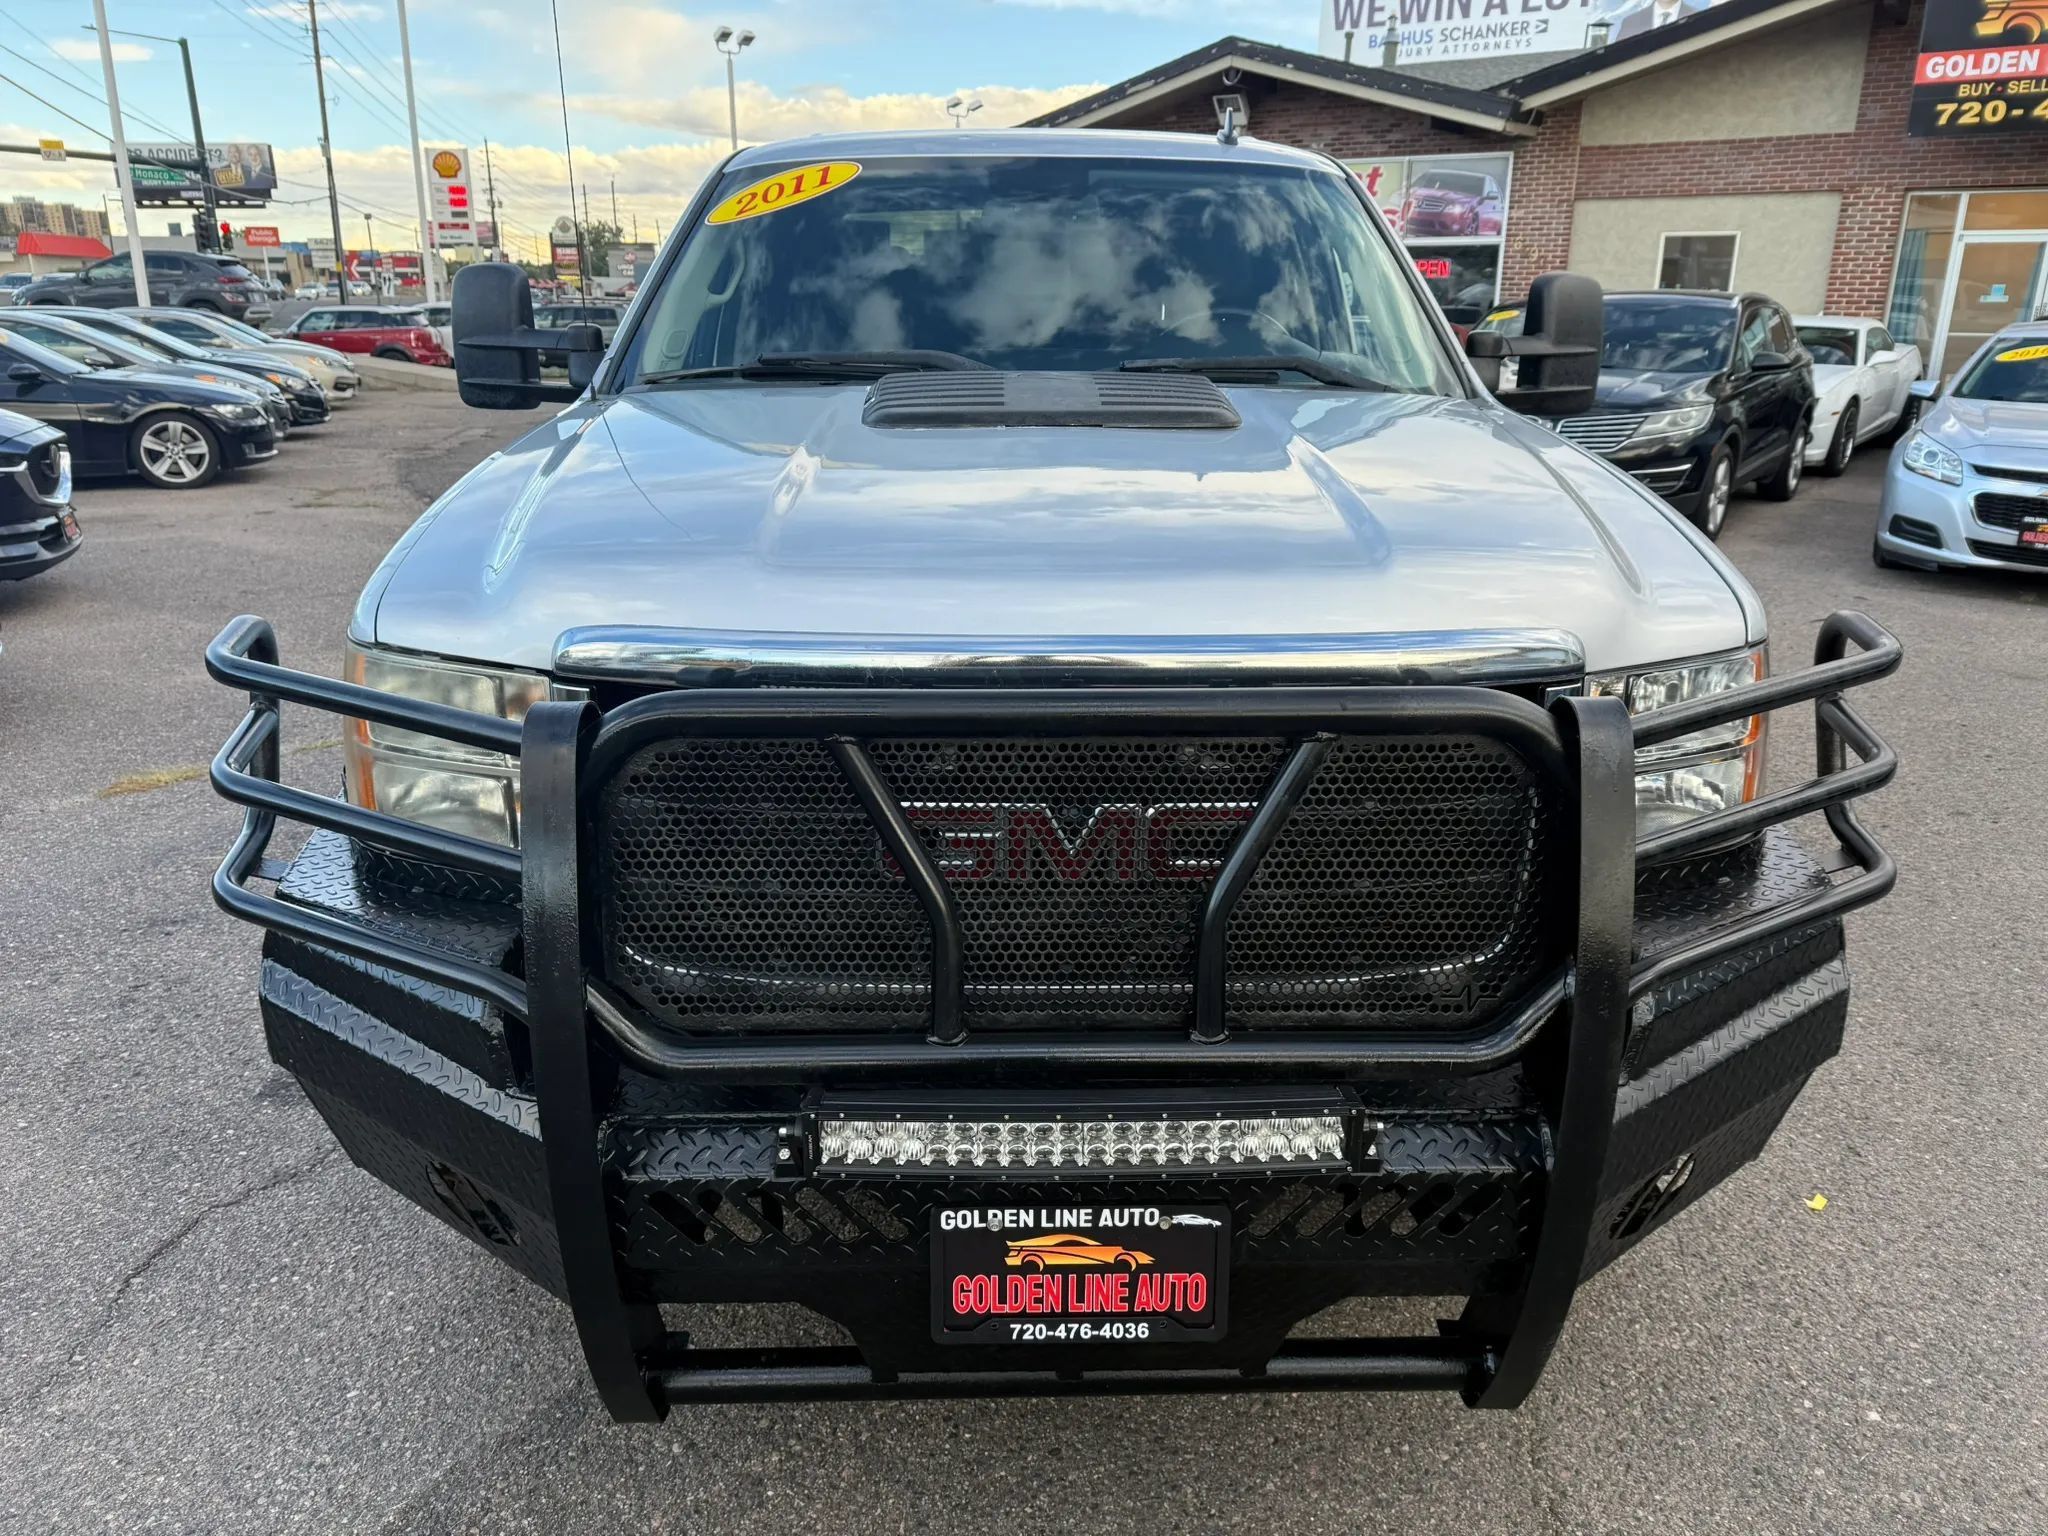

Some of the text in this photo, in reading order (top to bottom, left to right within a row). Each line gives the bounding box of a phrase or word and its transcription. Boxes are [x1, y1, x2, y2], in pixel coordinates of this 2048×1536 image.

[1333, 0, 1386, 30] WE
[1368, 20, 1530, 49] BHUS SCHANKER
[1442, 37, 1532, 55] ATTORNEYS
[1926, 49, 2040, 79] GOLDEN
[1958, 78, 2048, 97] BUY SELL
[148, 147, 223, 163] ACCIDET?
[135, 168, 170, 180] Monaco
[735, 165, 832, 217] 2011
[1416, 259, 1450, 279] PEN
[876, 801, 1262, 881] GMC
[940, 1207, 1160, 1231] GOLDEN LINE AUTO
[952, 1272, 1207, 1315] GOLDEN LINE AUTO
[1009, 1321, 1150, 1341] 720-476-4036
